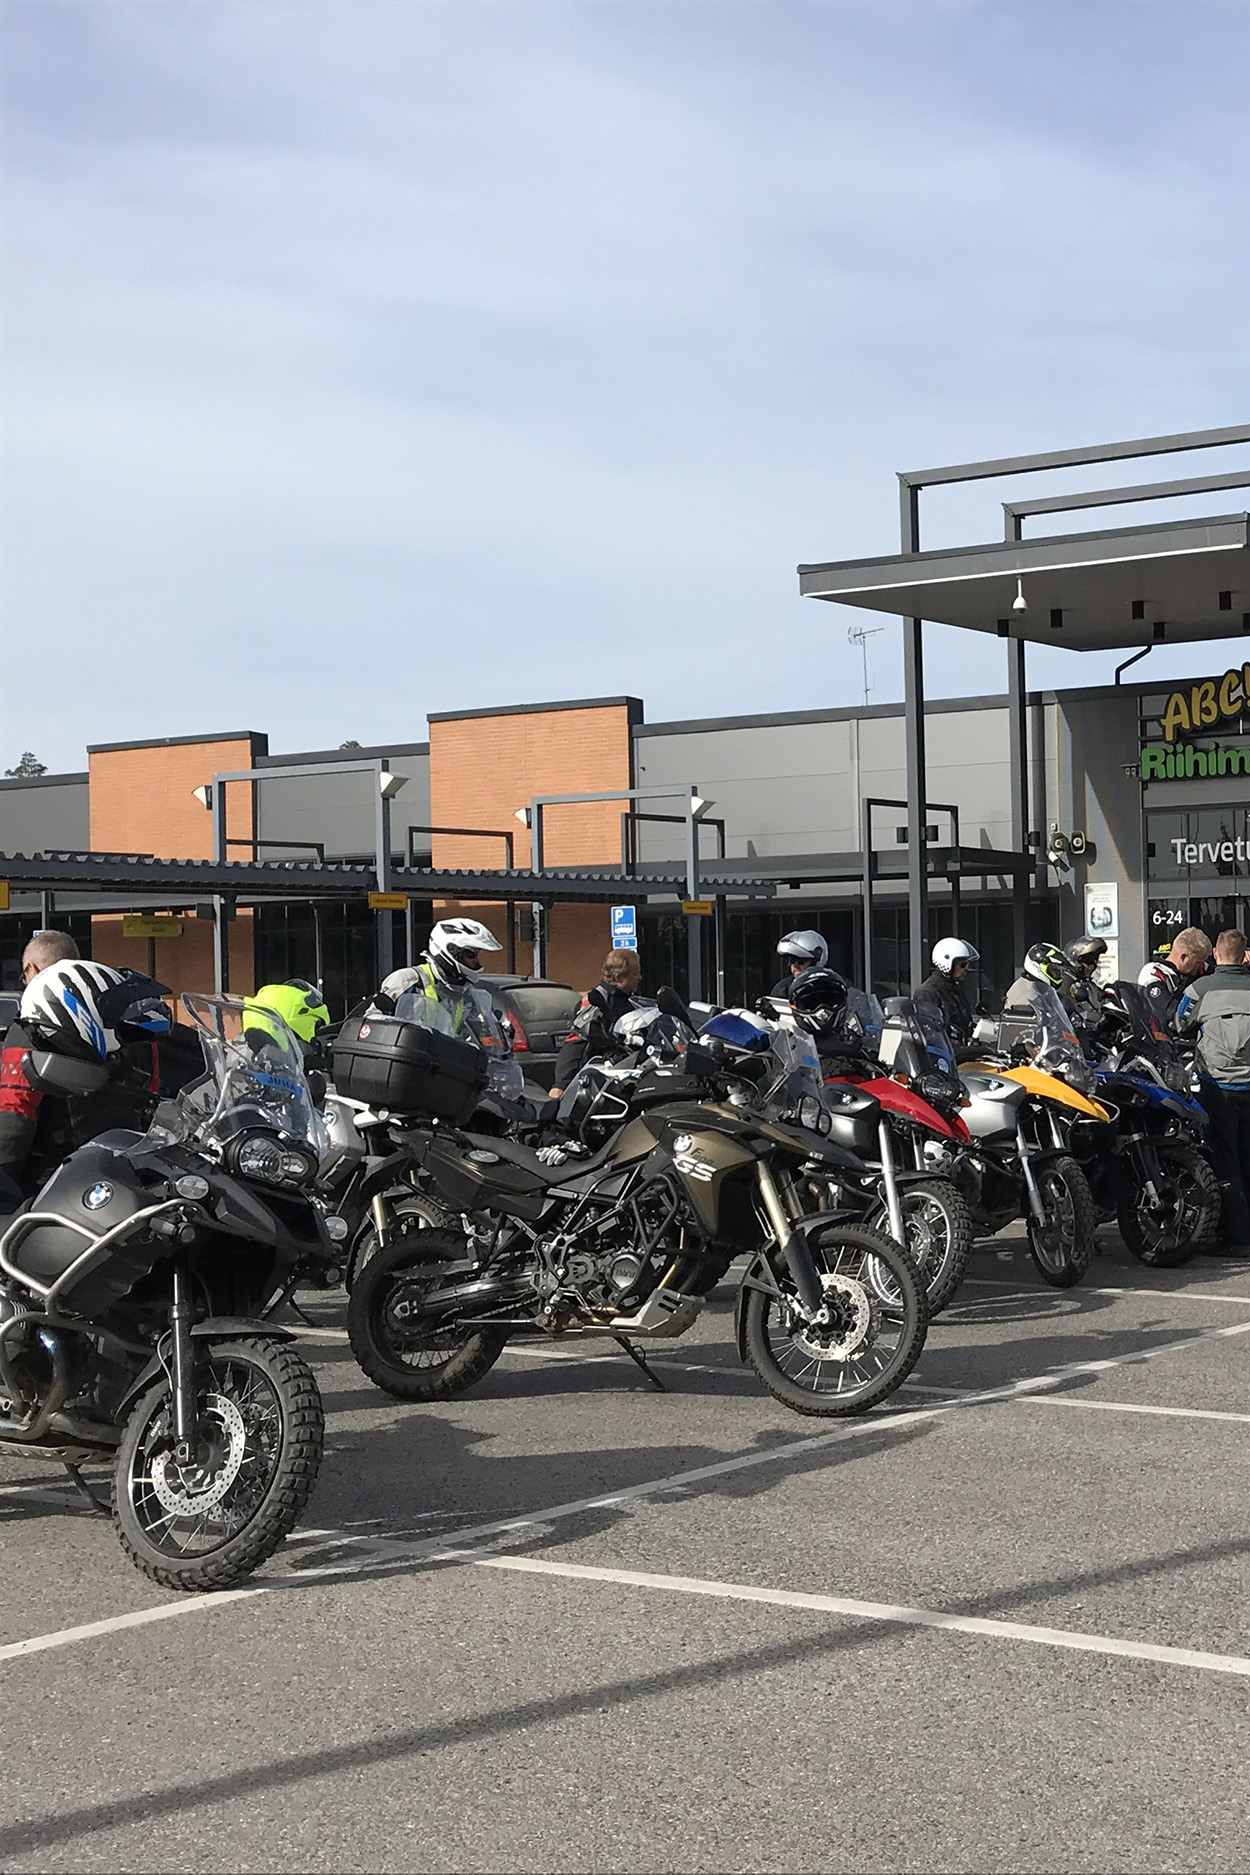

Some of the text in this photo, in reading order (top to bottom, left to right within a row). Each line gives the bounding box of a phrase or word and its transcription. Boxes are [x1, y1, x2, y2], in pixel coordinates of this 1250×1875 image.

[614, 909, 624, 923] P
[1152, 910, 1183, 925] 6-24
[672, 1153, 717, 1182] GS
